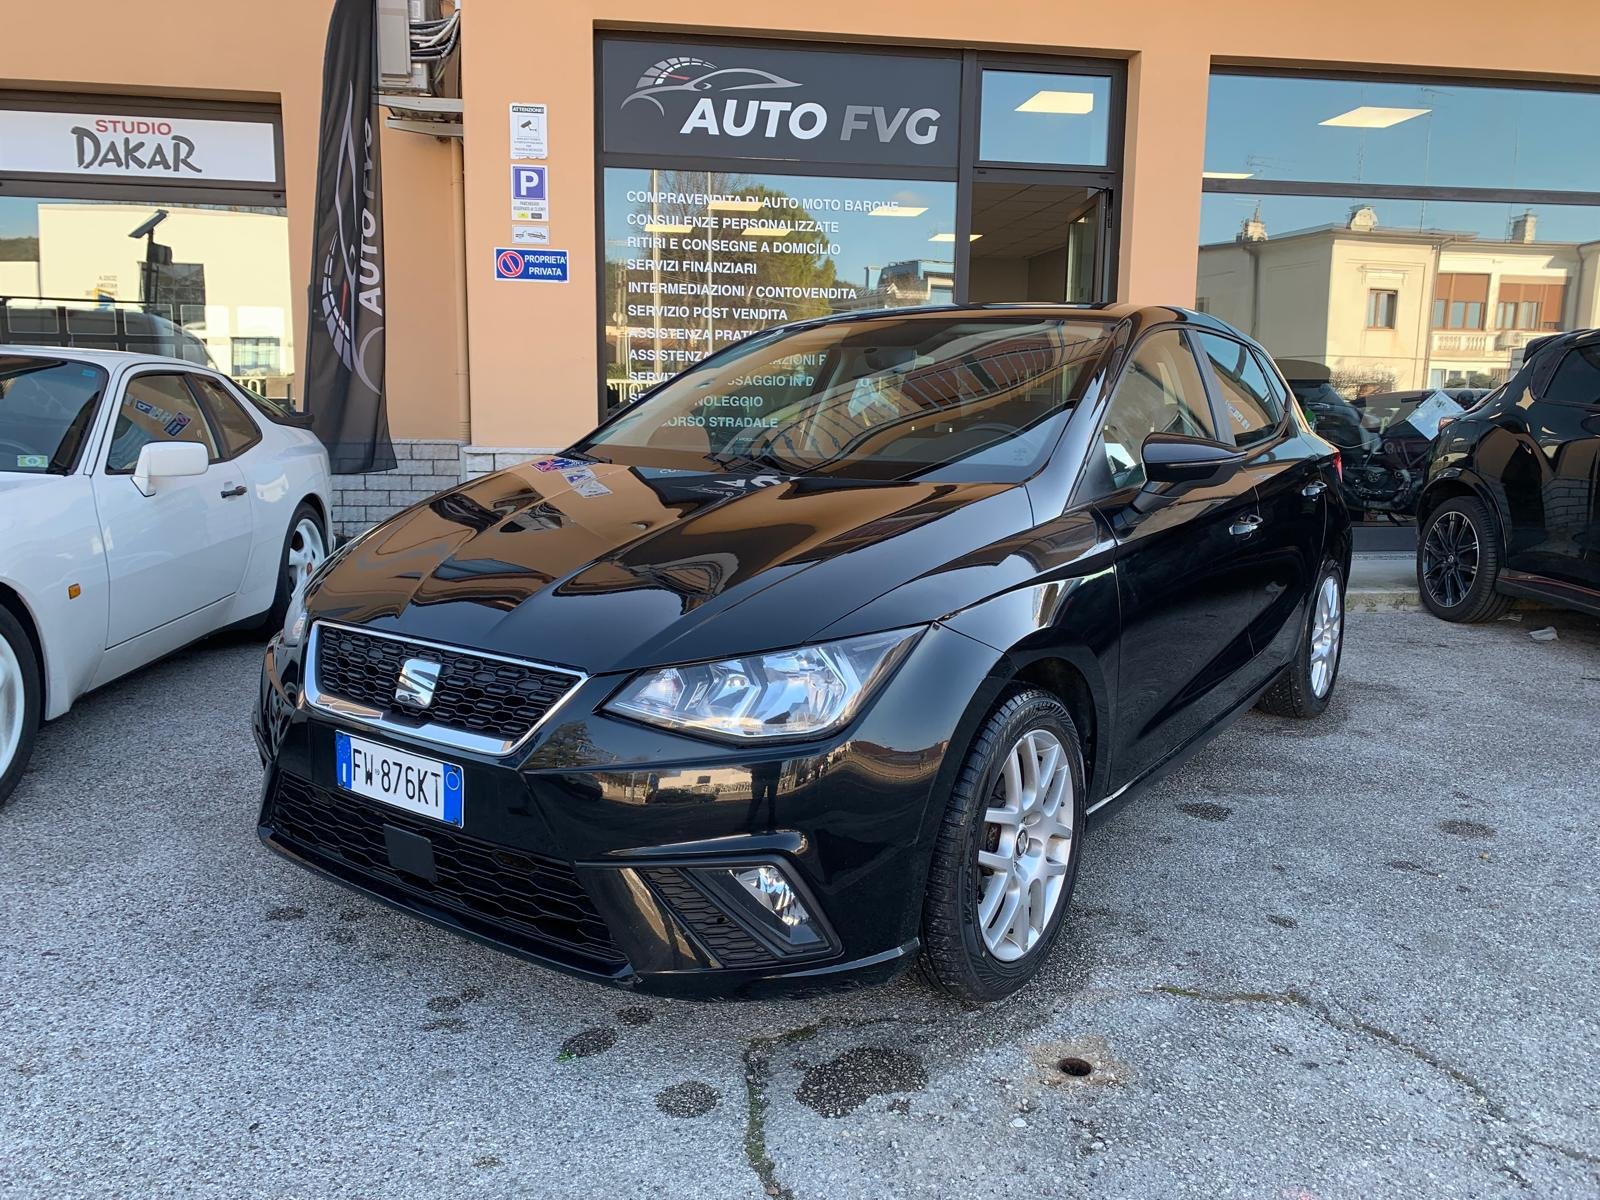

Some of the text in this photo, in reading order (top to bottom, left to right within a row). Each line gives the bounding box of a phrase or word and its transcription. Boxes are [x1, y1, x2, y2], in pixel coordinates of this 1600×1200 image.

[95, 119, 172, 136] STUDIO
[679, 97, 941, 145] AUTO FVG
[70, 127, 203, 173] DAKAR
[626, 191, 741, 205] COMPRAVENDITA
[762, 197, 799, 209] AUTO
[803, 198, 840, 211] MOTO
[844, 200, 899, 212] BARCHE
[627, 214, 839, 233] CONSULENZE PERSONALIZZATE
[627, 236, 841, 255] RITIRI E CONSEGNE A DOMICILIO
[358, 207, 383, 317] AUTO
[627, 259, 757, 274] SERVIZI FINANZIARI
[529, 267, 562, 276] PRIVATA
[628, 281, 745, 297] INTERMEDIAZIONI
[756, 286, 857, 299] CONTOVENDITA
[627, 304, 789, 320] SERVIZIO POST VENDITA
[629, 327, 759, 341] ASSISTENZA PRAT
[709, 416, 778, 428] STRADALE
[381, 759, 441, 807] 876KT
